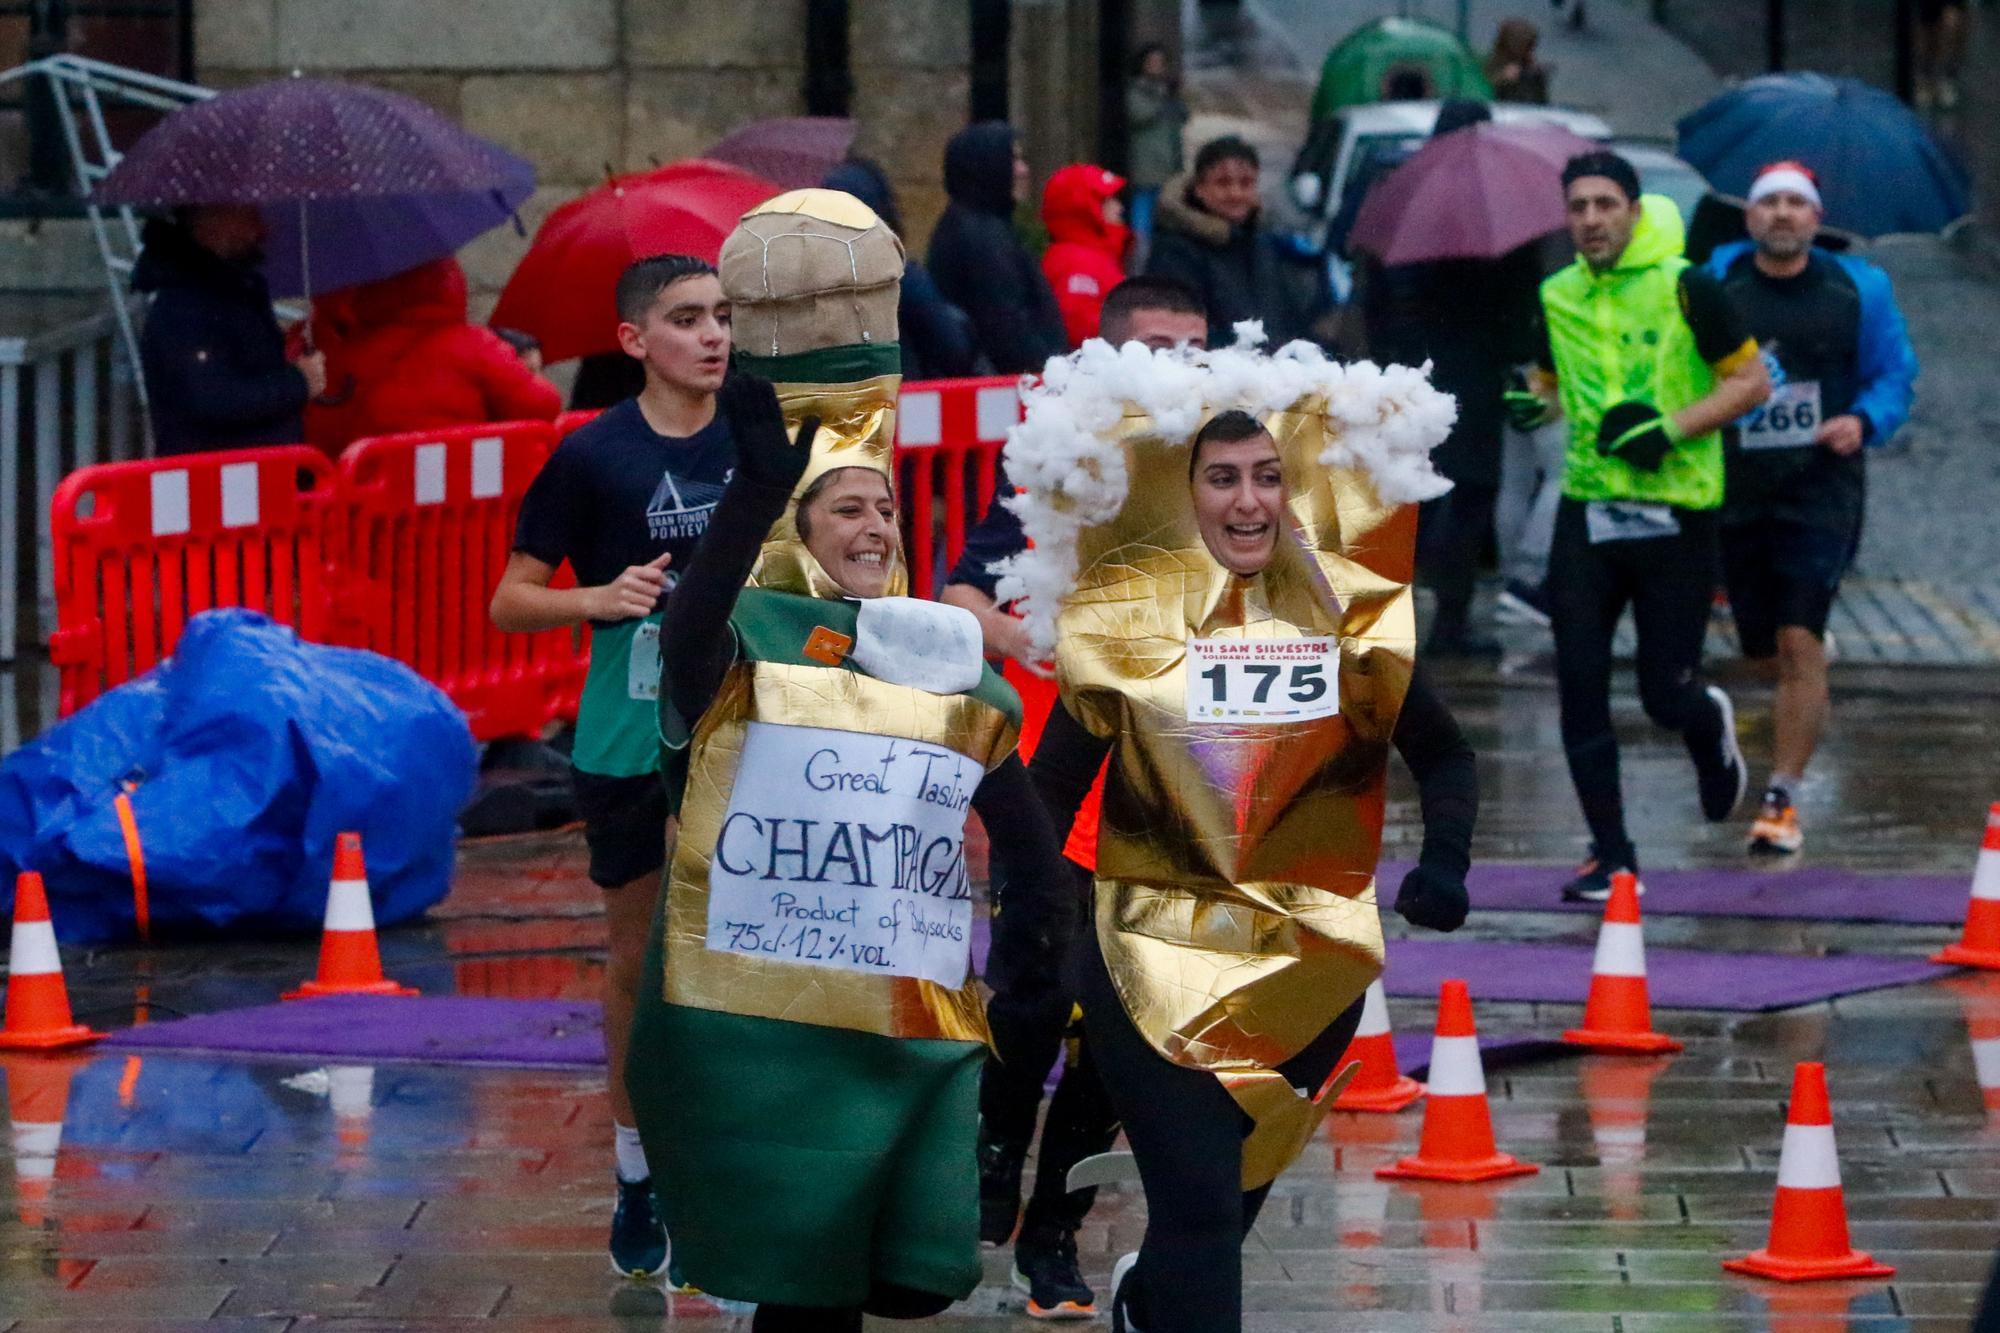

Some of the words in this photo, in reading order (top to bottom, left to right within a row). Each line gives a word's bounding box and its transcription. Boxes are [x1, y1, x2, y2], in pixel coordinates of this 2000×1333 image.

[1748, 402, 1814, 433] 266
[648, 515, 675, 528] GRAN
[677, 510, 708, 525] FONDO
[1194, 644, 1213, 653] VII
[1219, 644, 1250, 653] SAN
[1256, 642, 1329, 653] SILVESTRE
[1202, 664, 1328, 703] 175
[804, 740, 896, 794] Great
[771, 891, 861, 928] Product
[879, 899, 902, 946] of
